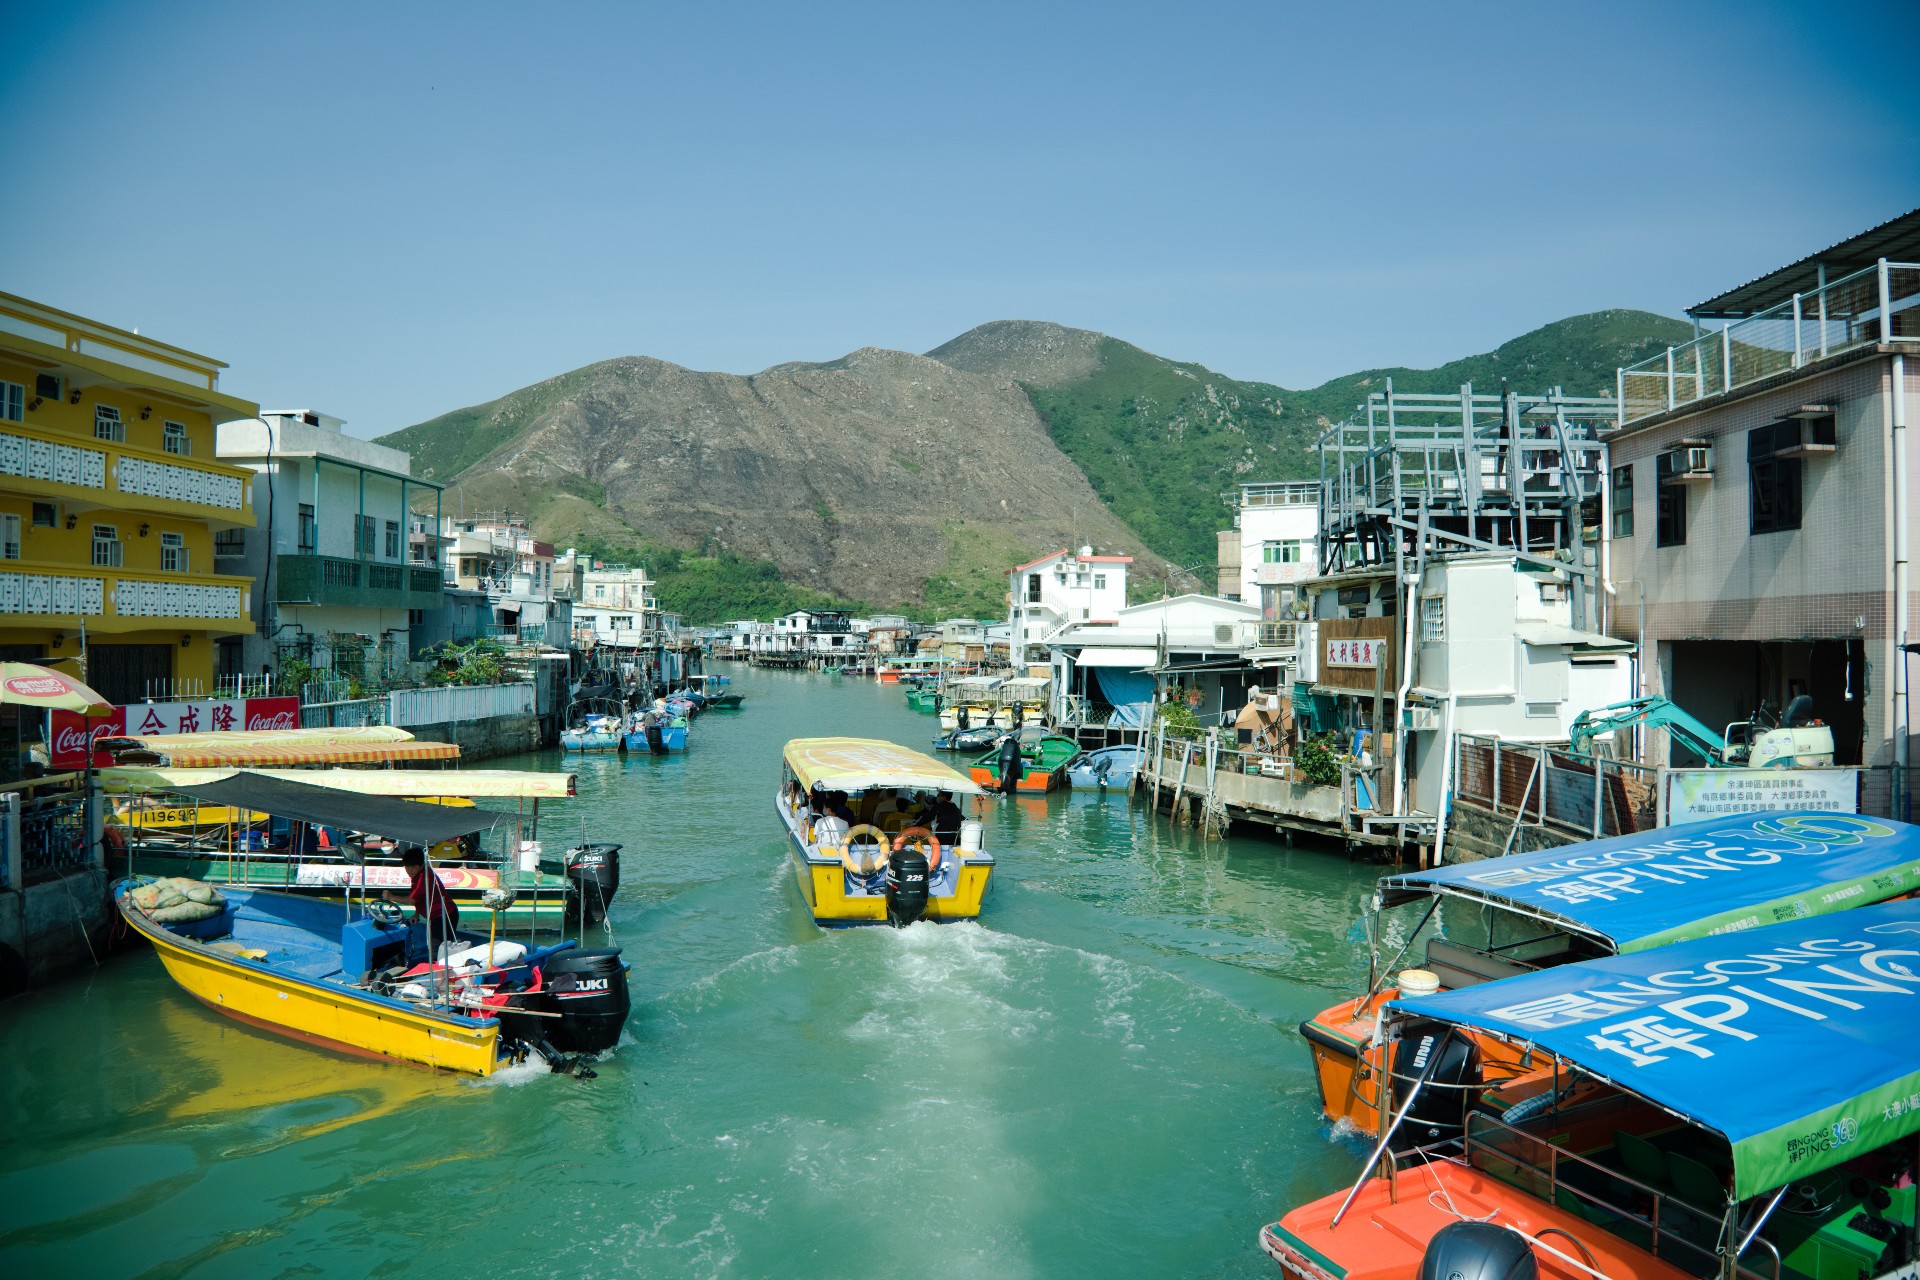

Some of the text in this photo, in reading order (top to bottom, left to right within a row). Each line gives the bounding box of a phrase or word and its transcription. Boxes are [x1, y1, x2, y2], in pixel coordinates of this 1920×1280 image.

[1329, 642, 1379, 663] 大利福魚
[138, 703, 238, 736] 合成隆
[248, 711, 296, 731] Coca-Cola
[56, 723, 122, 754] Coca-C
[905, 874, 924, 882] 225
[1412, 1035, 1435, 1068] 225
[1798, 1138, 1831, 1161] PING
